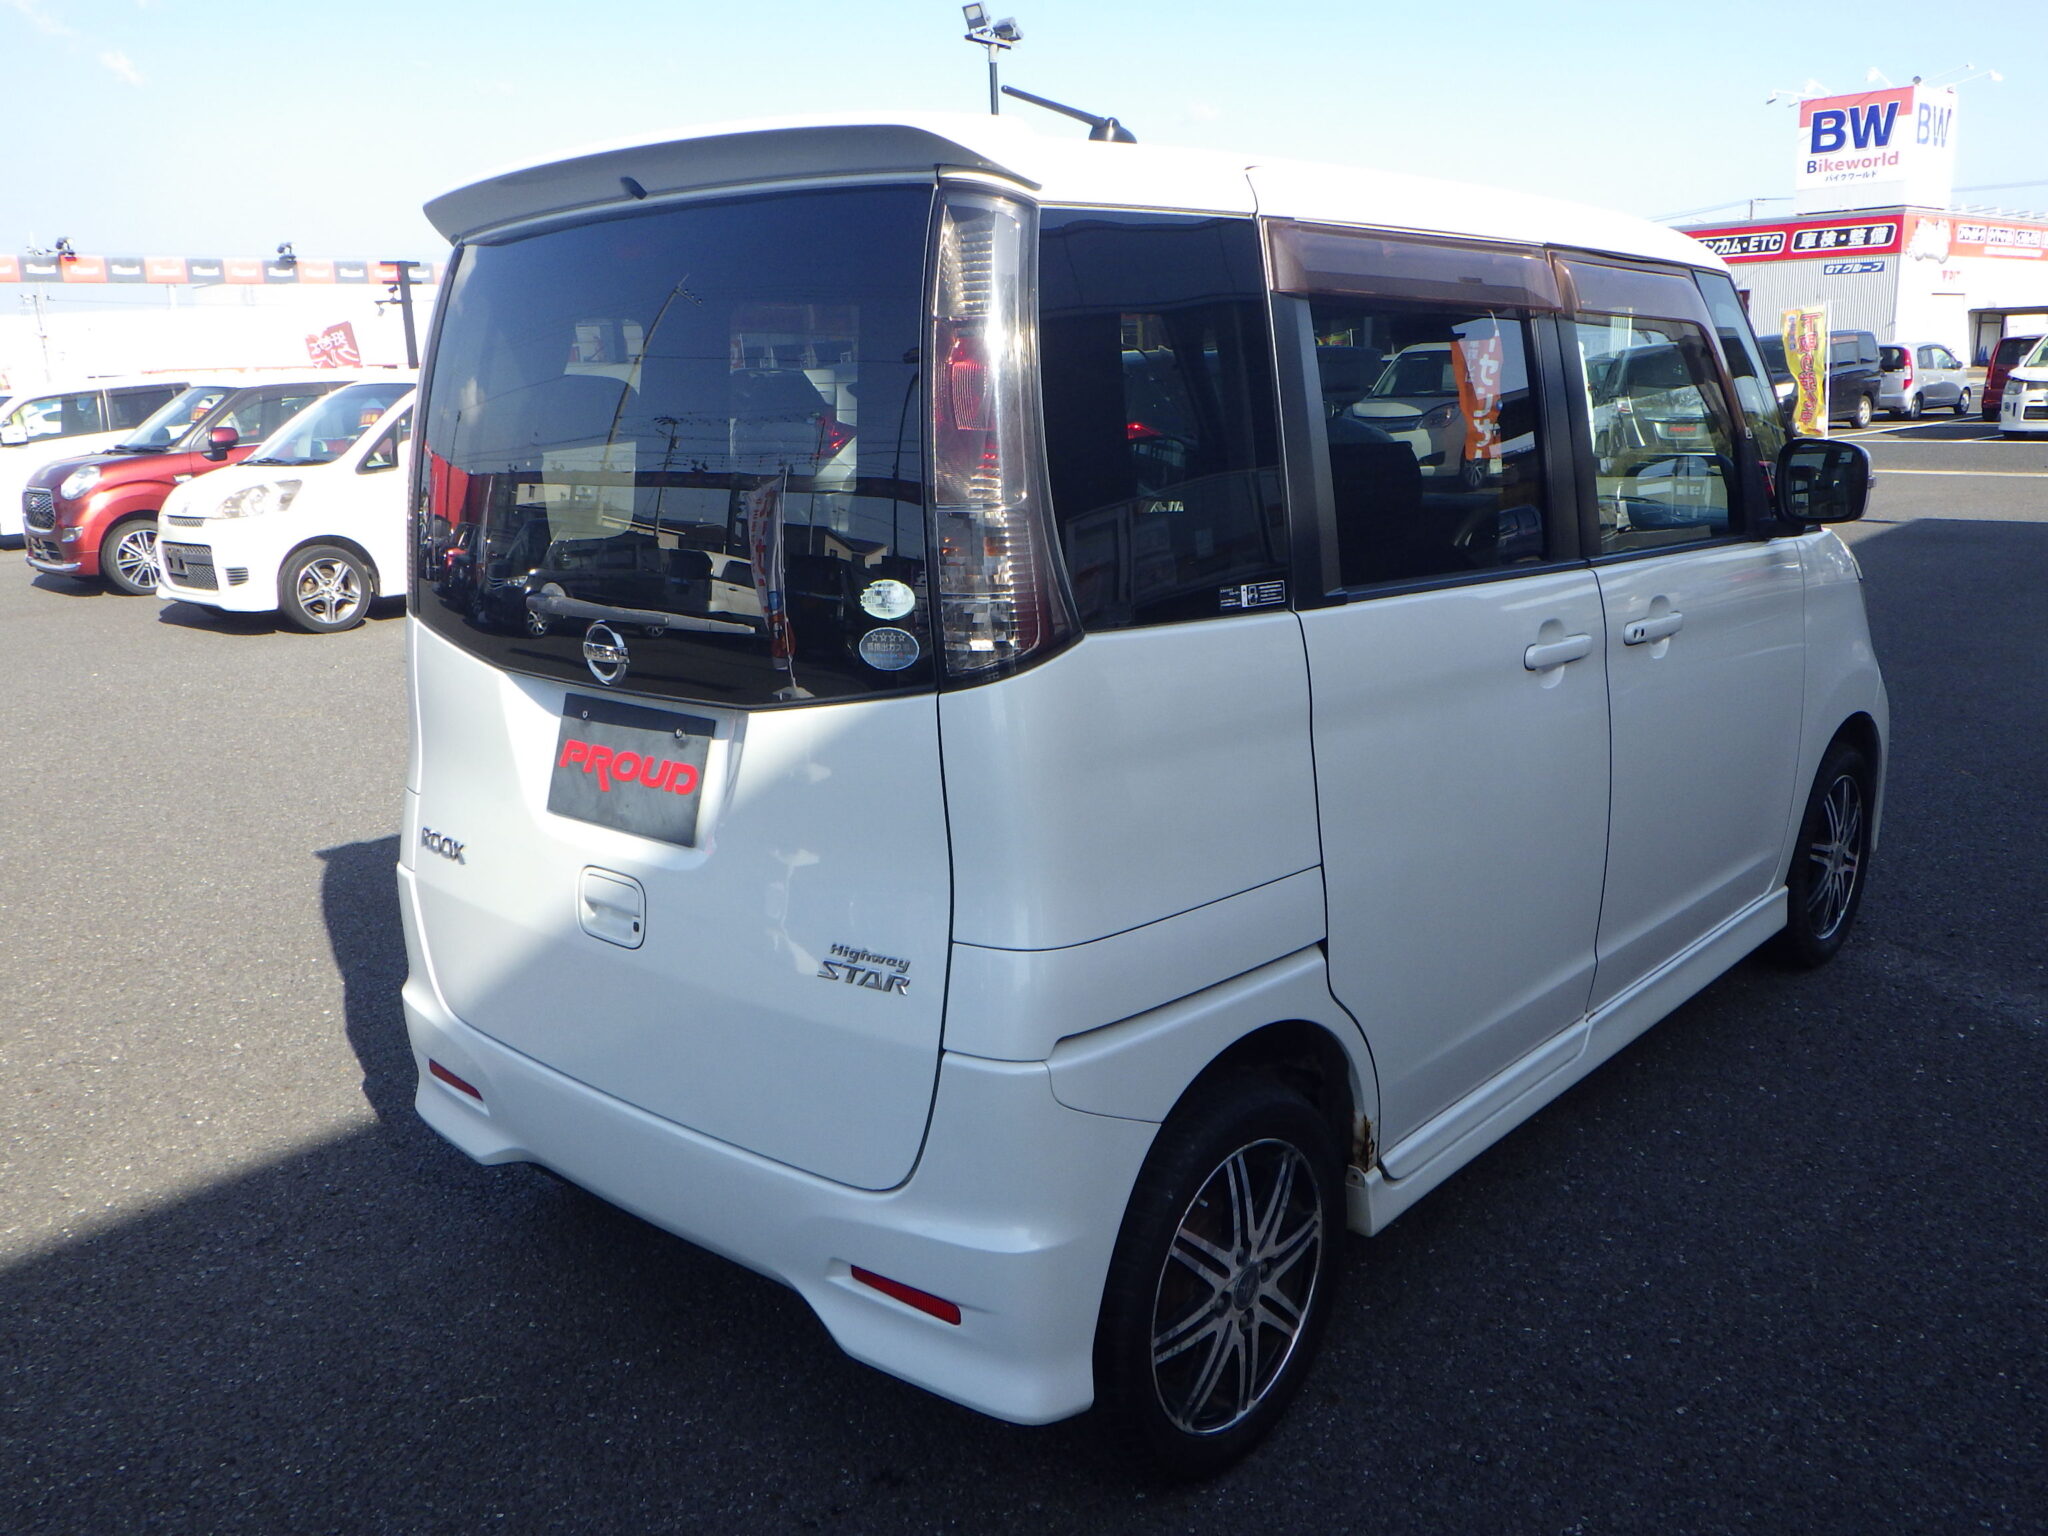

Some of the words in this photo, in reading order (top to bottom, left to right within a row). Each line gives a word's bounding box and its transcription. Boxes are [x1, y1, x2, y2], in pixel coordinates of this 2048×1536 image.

[1811, 102, 1900, 154] BW
[1916, 102, 1952, 148] BW
[1806, 151, 1900, 174] Bikeworld
[1799, 226, 1889, 249] 車検・整備
[559, 739, 699, 796] PROUD
[421, 826, 466, 866] ROOX
[829, 943, 911, 974] Highway
[817, 961, 911, 996] STAR
